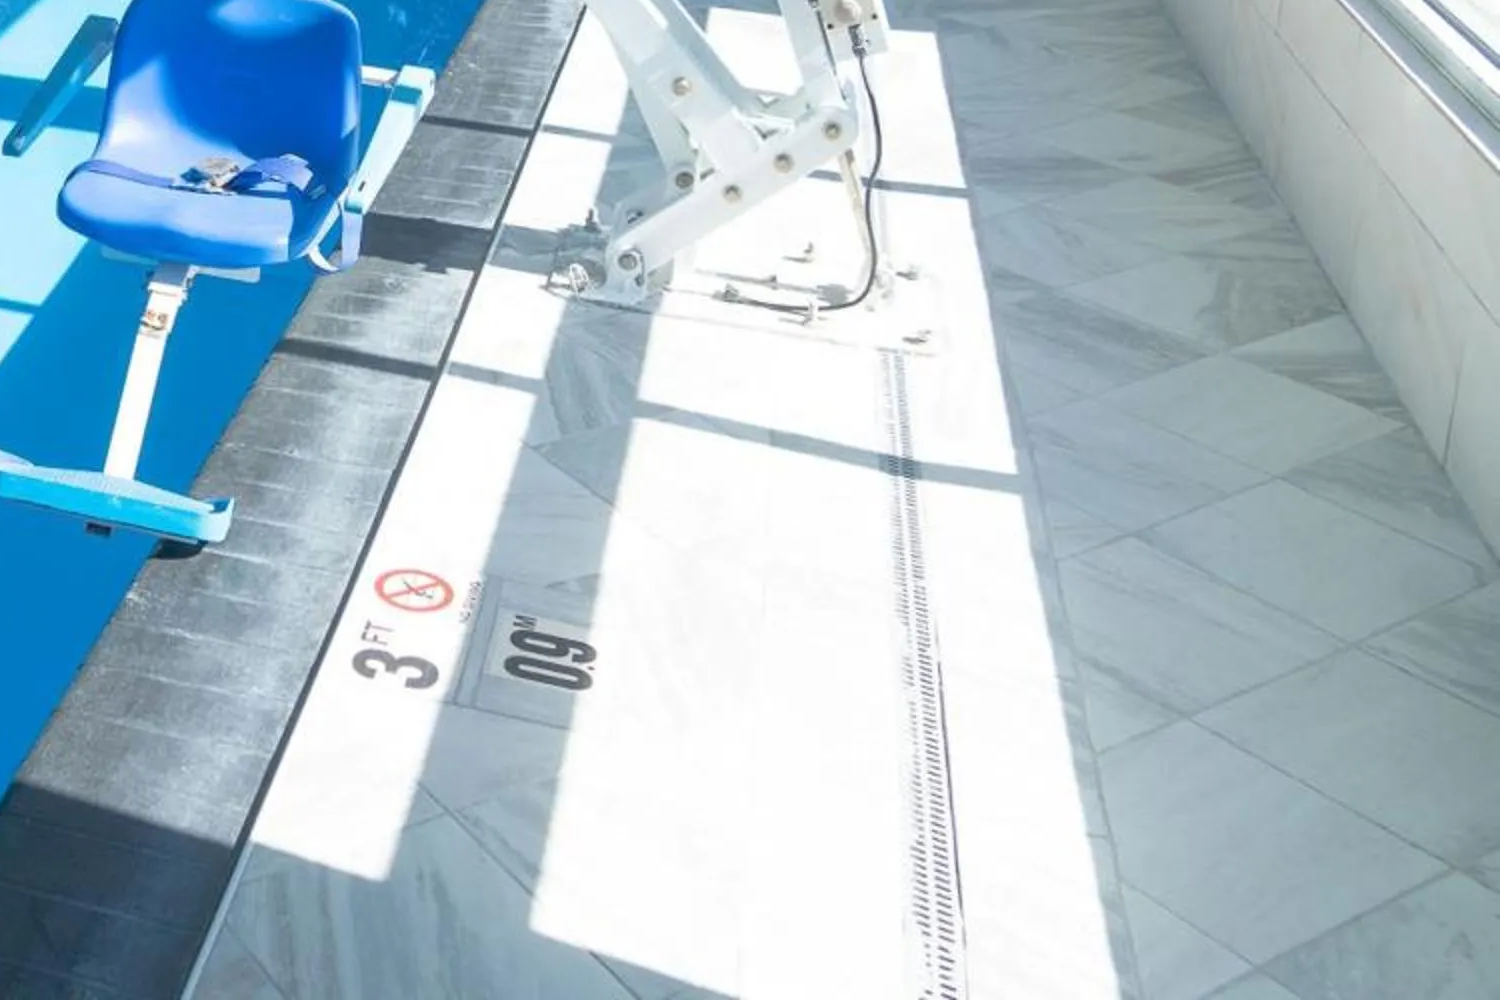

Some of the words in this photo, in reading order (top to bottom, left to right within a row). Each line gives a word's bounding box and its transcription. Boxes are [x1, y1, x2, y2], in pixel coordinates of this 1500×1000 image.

[361, 620, 395, 646] FT
[512, 614, 537, 631] M
[351, 648, 440, 690] 3
